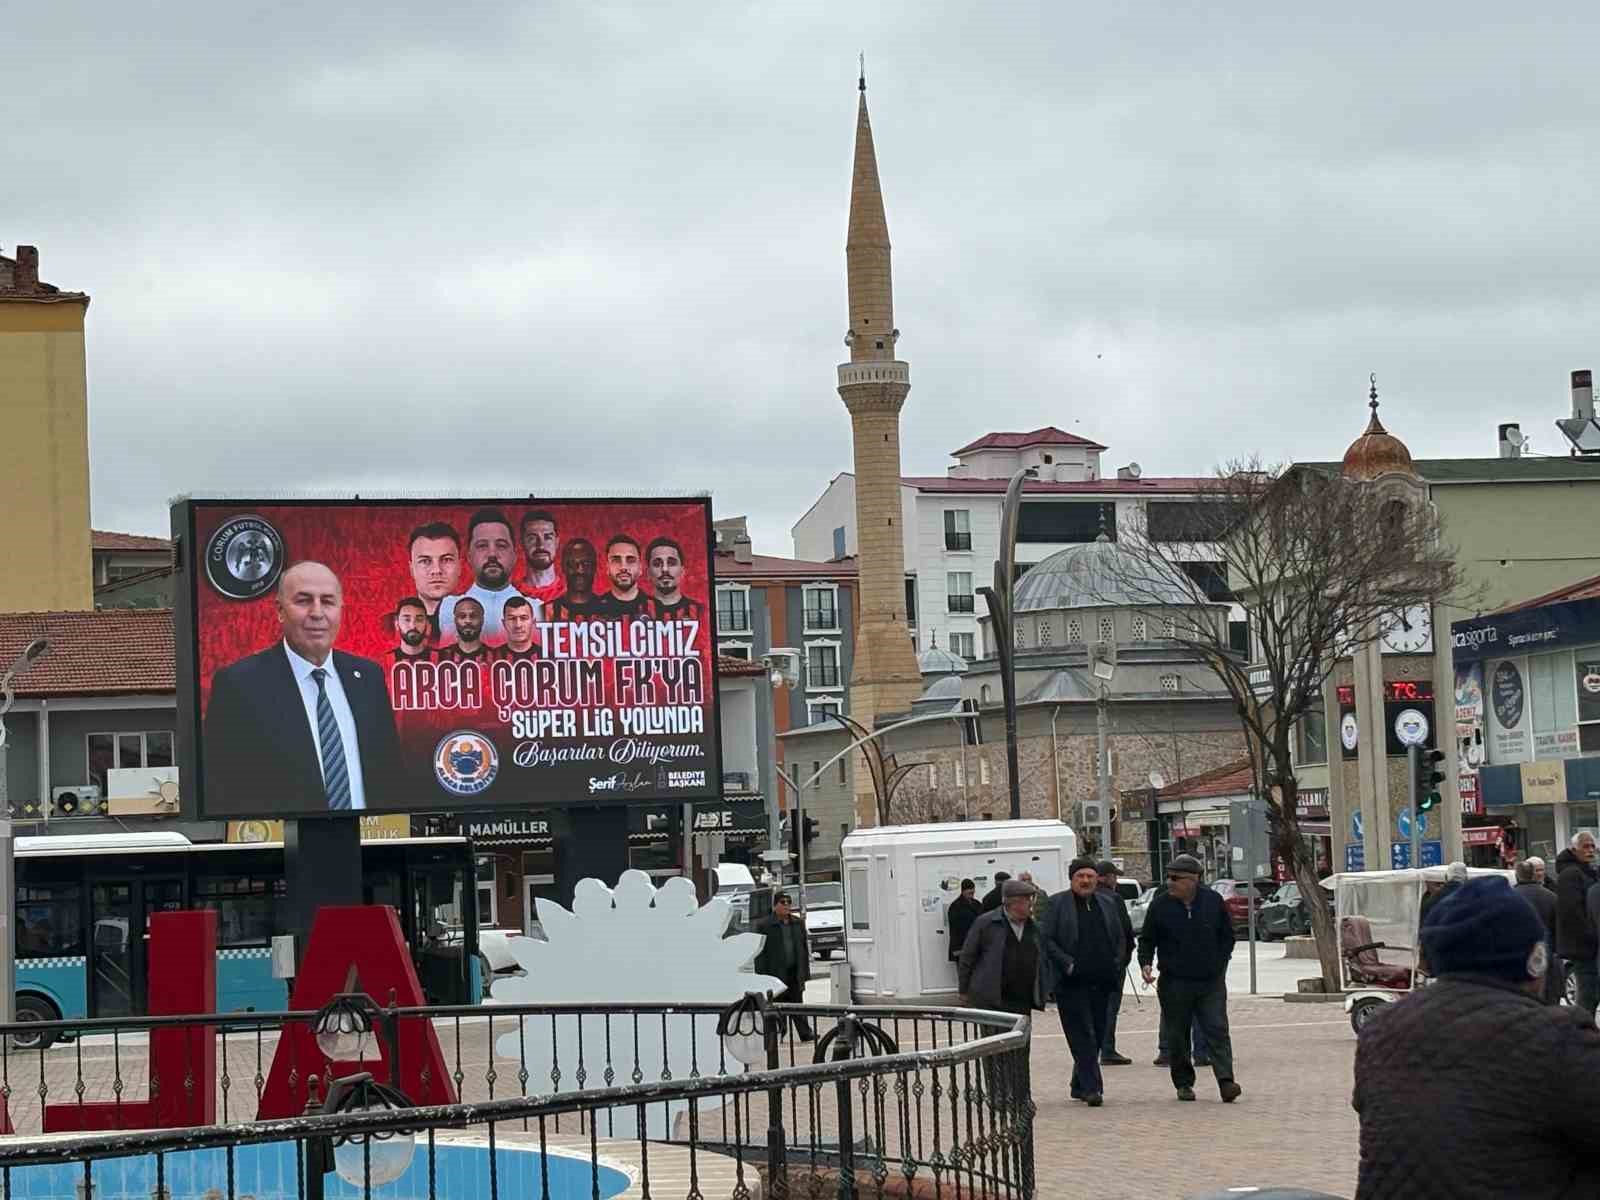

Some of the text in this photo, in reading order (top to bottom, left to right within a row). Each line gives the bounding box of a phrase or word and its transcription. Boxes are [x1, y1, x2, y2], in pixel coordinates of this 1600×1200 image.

[536, 621, 700, 658] TEMSİLCİMİZ
[392, 657, 704, 722] ARCA ÇORUM FK'YA
[512, 705, 704, 739] SÜPER LİG YOLUNDA
[513, 738, 705, 767] Başarılar Diliyorum.
[588, 776, 617, 793] Şerif
[469, 819, 549, 836] MAMÜLLER
